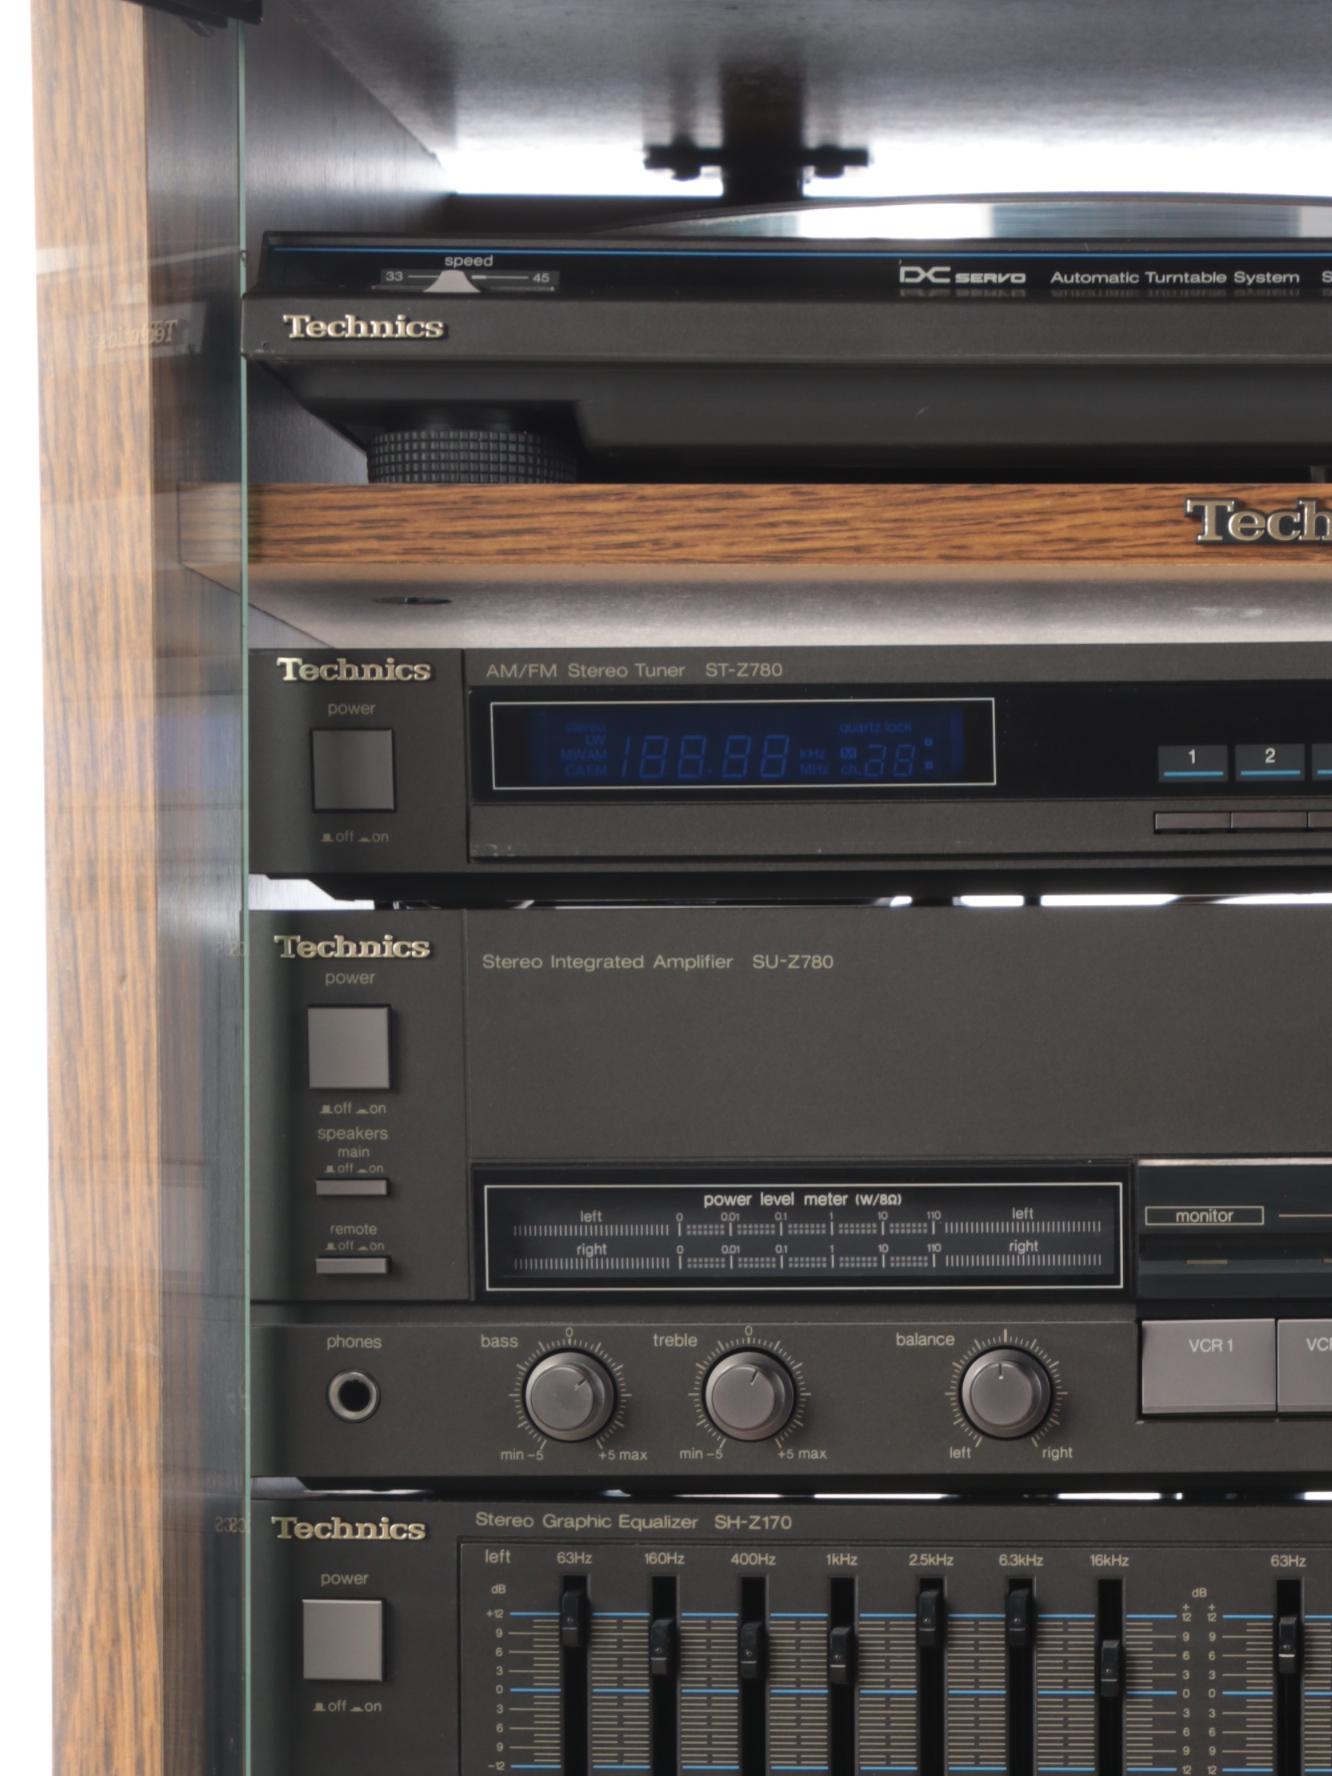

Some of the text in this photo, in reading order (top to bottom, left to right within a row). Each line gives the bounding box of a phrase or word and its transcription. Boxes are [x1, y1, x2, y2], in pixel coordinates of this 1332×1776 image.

[444, 253, 494, 269] speed
[955, 273, 1026, 284] SERVO
[1050, 271, 1140, 284] Automatic
[1144, 271, 1228, 284] Turntable
[1233, 270, 1300, 286] System
[282, 313, 443, 338] Technics
[276, 656, 431, 682] Technics
[486, 662, 783, 679] AM/FM Stereo Tuner ST-Z780
[327, 703, 377, 717] power
[273, 933, 431, 958] Technics
[482, 953, 834, 973] Stereo Integrated Amplifier SU-Z780
[325, 972, 376, 987] power
[317, 1126, 389, 1142] speakers
[337, 1147, 370, 1159] main
[703, 1194, 753, 1209] power
[760, 1191, 795, 1207] level
[803, 1192, 849, 1207] meter
[1175, 1207, 1234, 1224] monitor
[330, 1223, 378, 1236] remote
[326, 1334, 383, 1351] phones
[480, 1333, 519, 1349] bass
[652, 1332, 698, 1348] treble
[895, 1331, 956, 1347] balance
[270, 1516, 426, 1541] Technics
[475, 1511, 793, 1532] Stereo Graphic Equalizer SH-Z170
[484, 1548, 511, 1564] left
[320, 1573, 369, 1587] power
